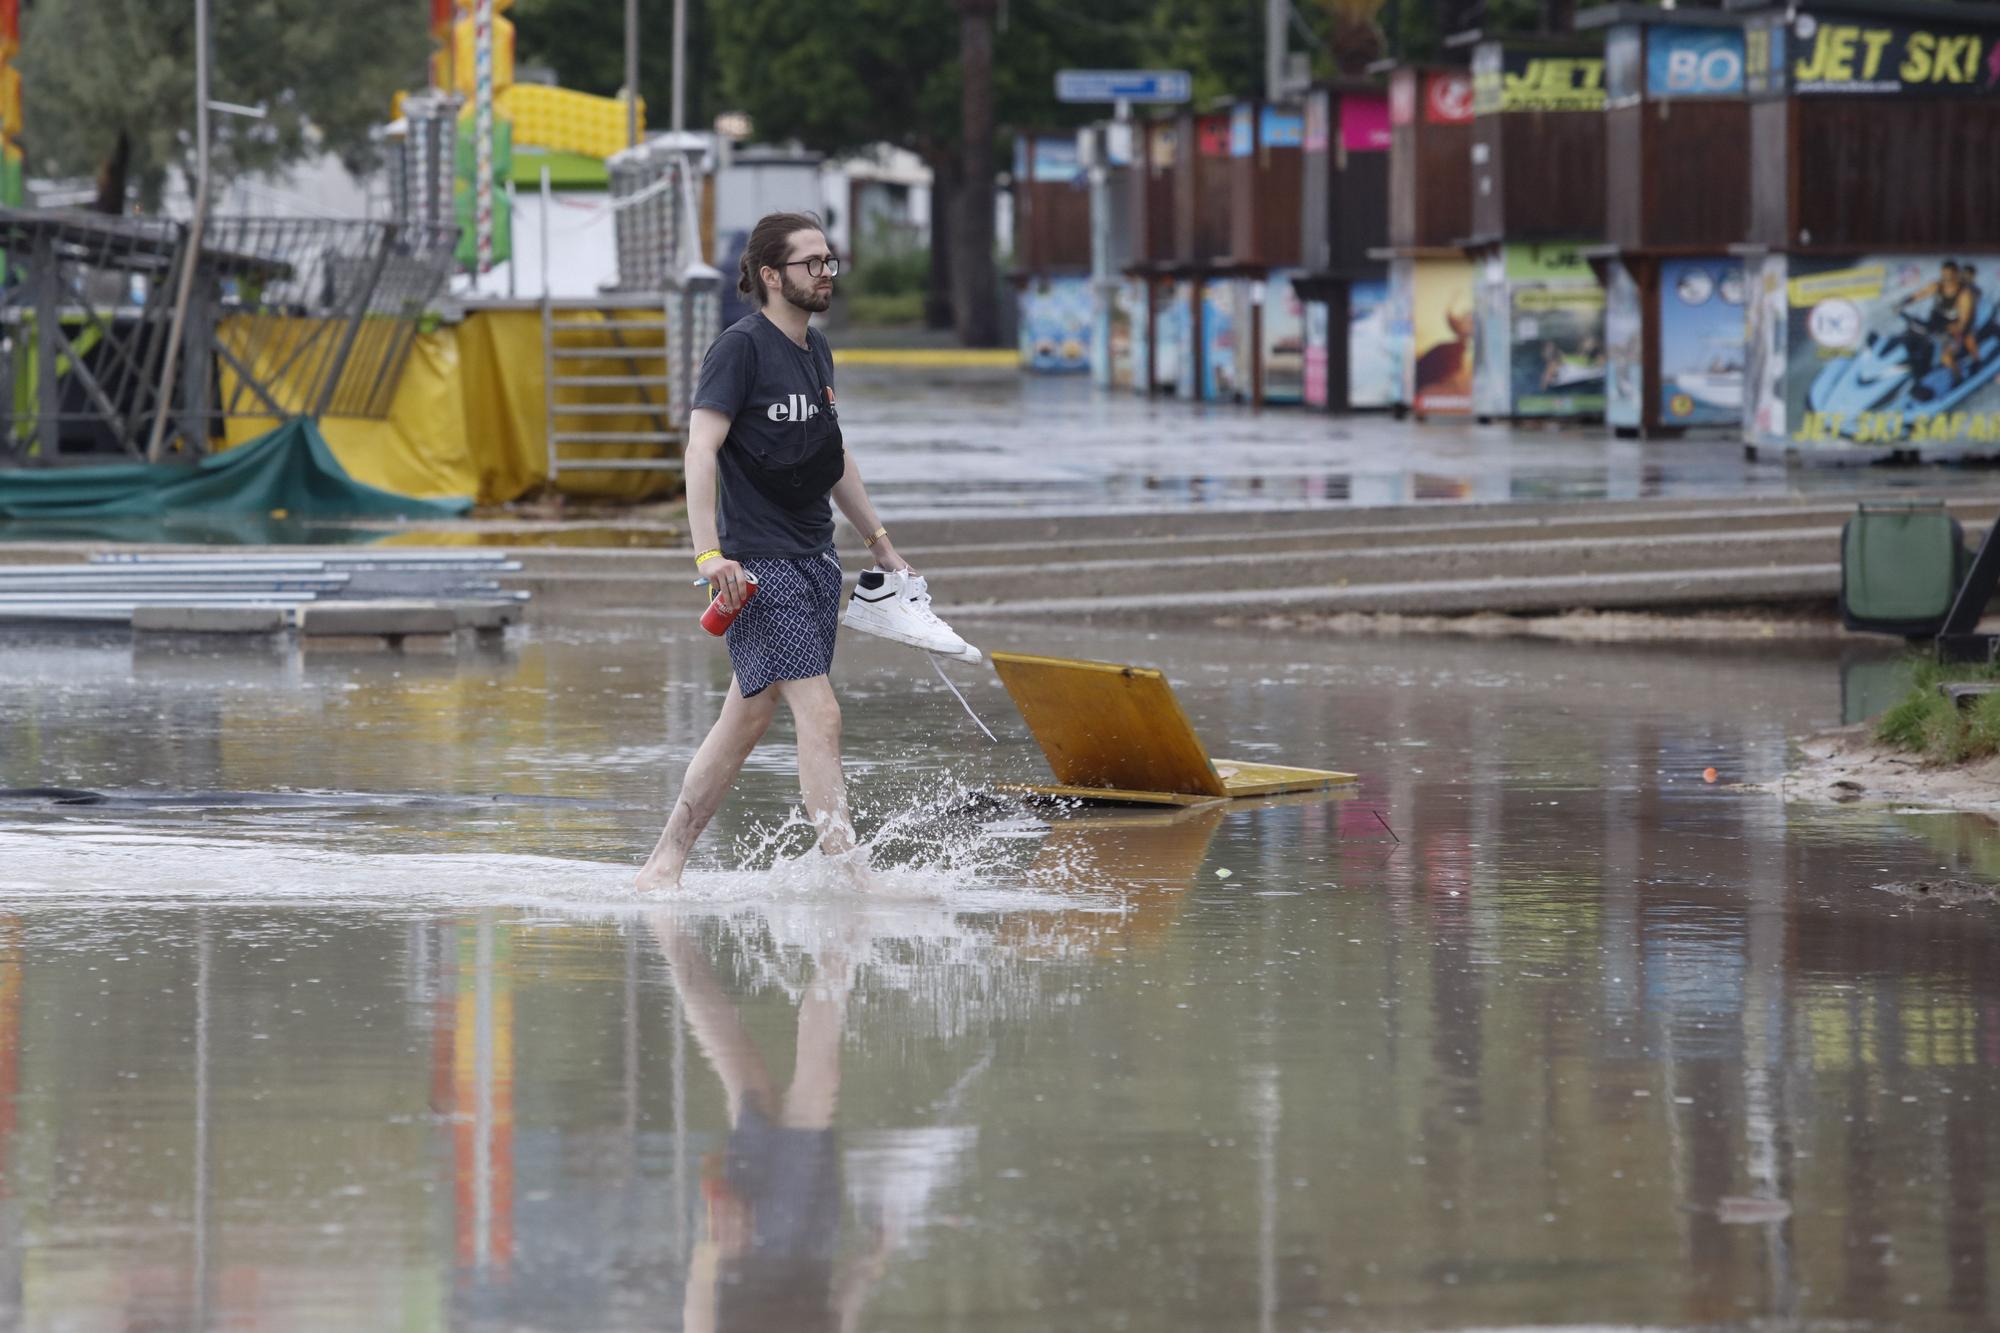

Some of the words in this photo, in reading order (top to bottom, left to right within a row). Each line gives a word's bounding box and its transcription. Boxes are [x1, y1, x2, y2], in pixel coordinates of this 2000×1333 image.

[1668, 48, 1742, 90] BO
[1795, 24, 1893, 81] JET
[1900, 31, 1982, 83] SKI
[1504, 58, 1605, 90] JET
[1854, 411, 1904, 443] SKI
